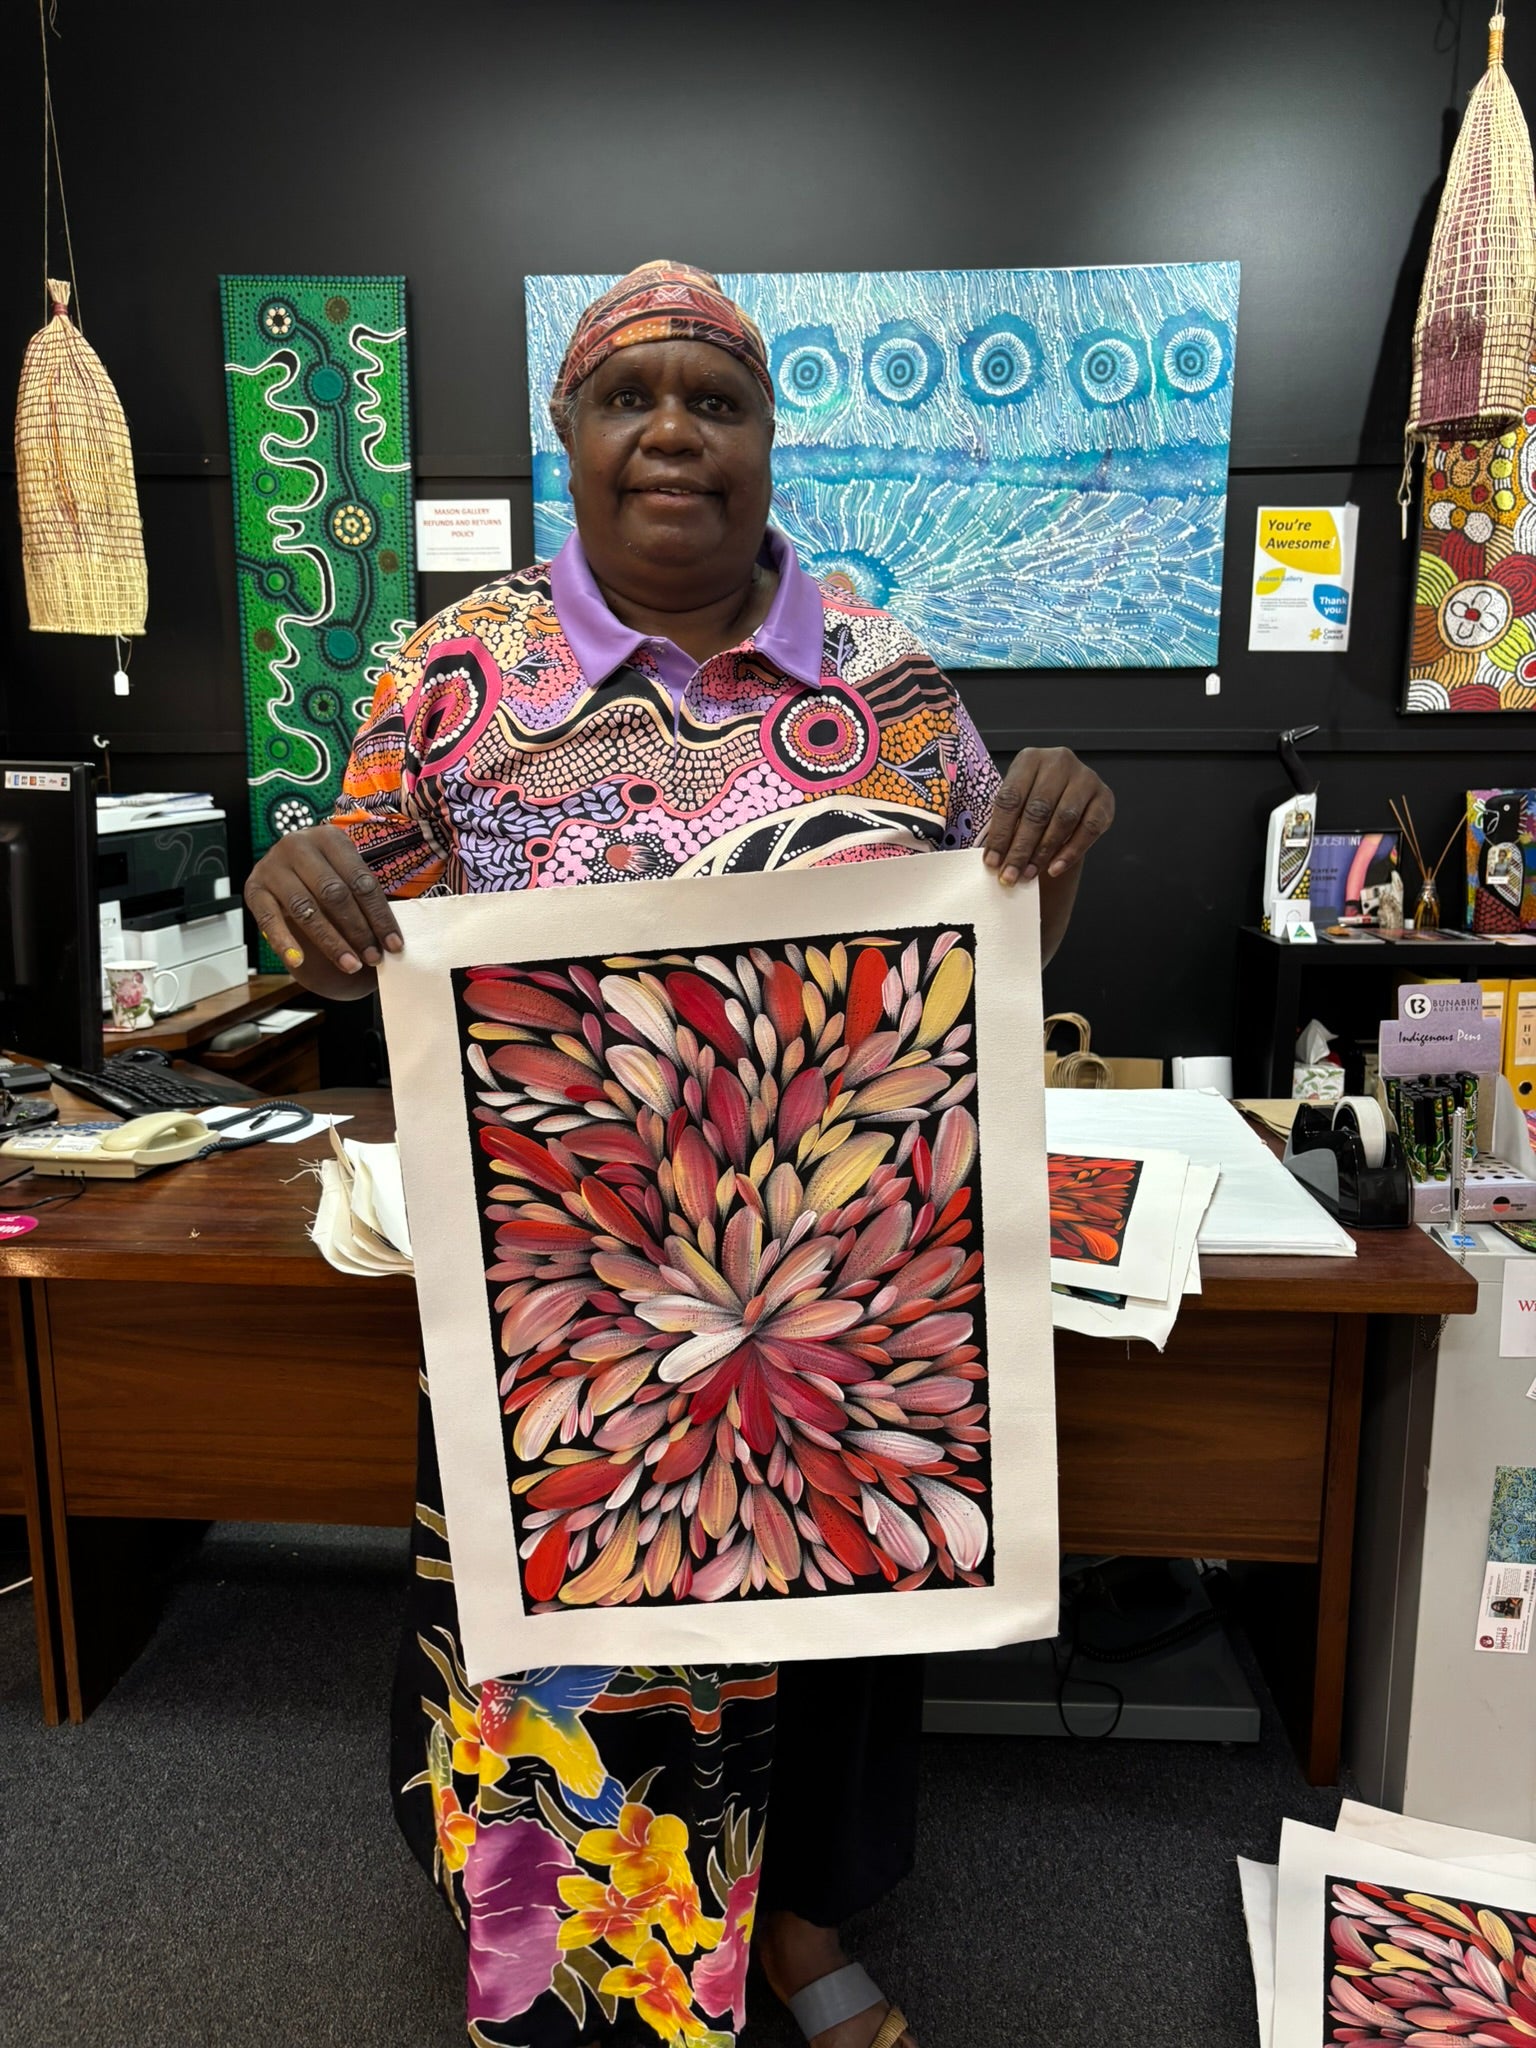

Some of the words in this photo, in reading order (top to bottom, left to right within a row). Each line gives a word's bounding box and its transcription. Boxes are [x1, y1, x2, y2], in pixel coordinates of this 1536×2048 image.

[1267, 519, 1312, 531] You're
[1265, 536, 1336, 549] Awesome!
[1319, 596, 1347, 605] Thank
[1432, 998, 1479, 1007] BUNABIRI
[1523, 1024, 1531, 1033] H
[1398, 1031, 1453, 1047] Indigenous
[1457, 1029, 1481, 1042] Pens
[1522, 1037, 1531, 1046] M
